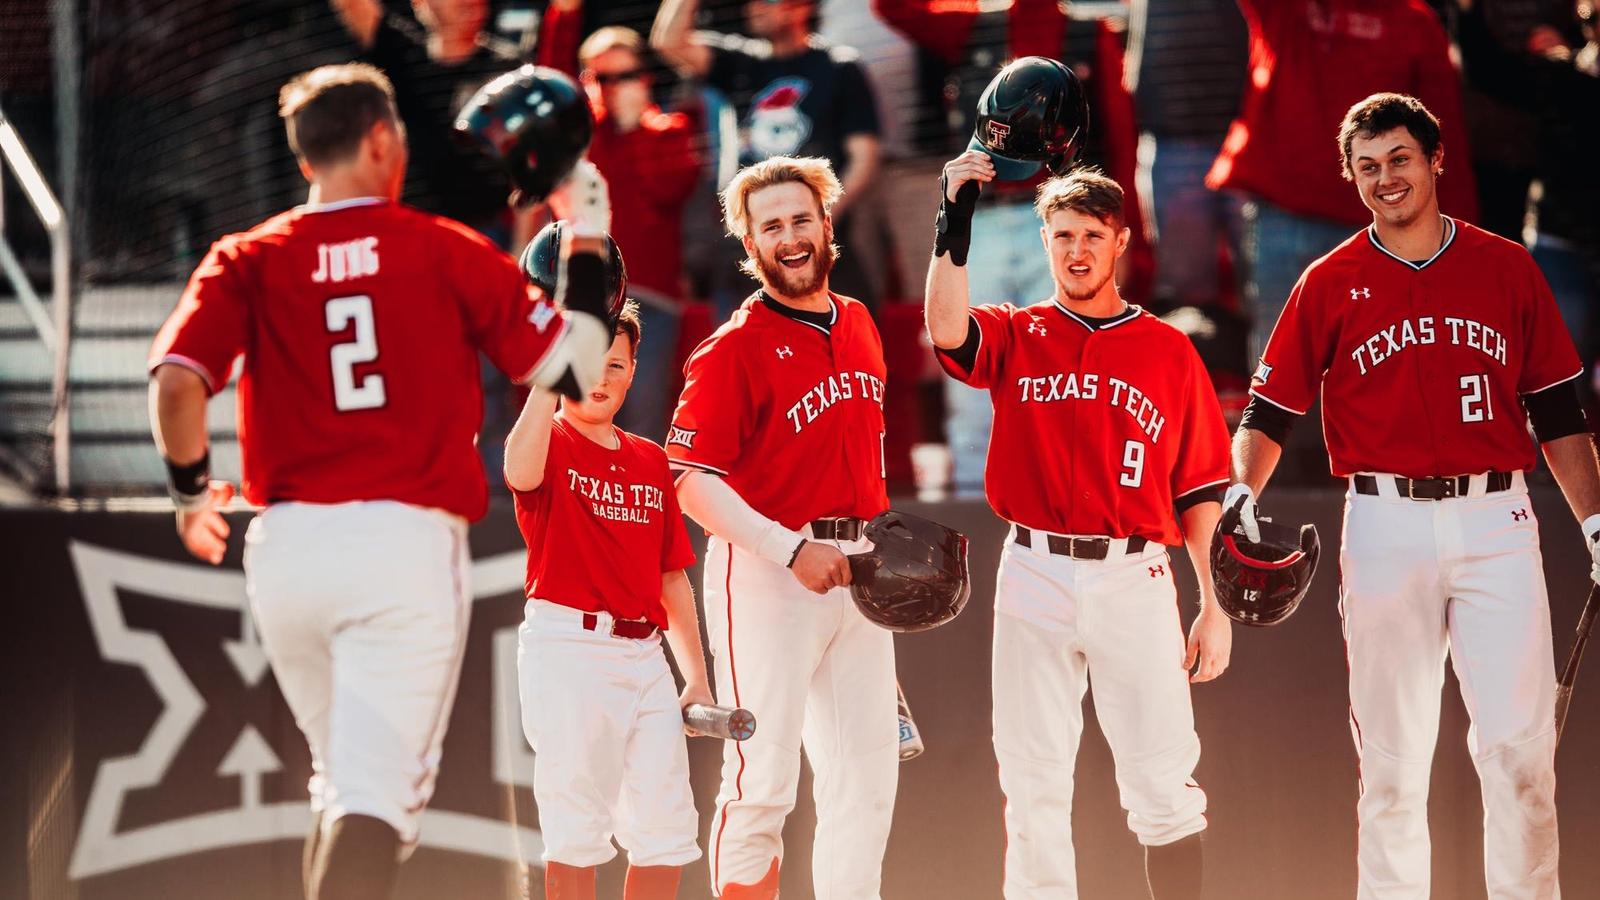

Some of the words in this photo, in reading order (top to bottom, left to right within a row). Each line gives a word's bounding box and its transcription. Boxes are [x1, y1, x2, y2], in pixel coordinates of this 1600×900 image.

[325, 294, 387, 412] 2
[1351, 316, 1436, 376] TEXAS
[1444, 316, 1507, 366] TECH
[786, 372, 853, 435] TEXAS
[1017, 372, 1099, 402] TEXAS
[1108, 377, 1166, 444] TECH
[1459, 373, 1494, 423] 21
[567, 468, 625, 505] TEXAS
[1119, 439, 1146, 488] 9
[591, 501, 650, 524] BASEBALL
